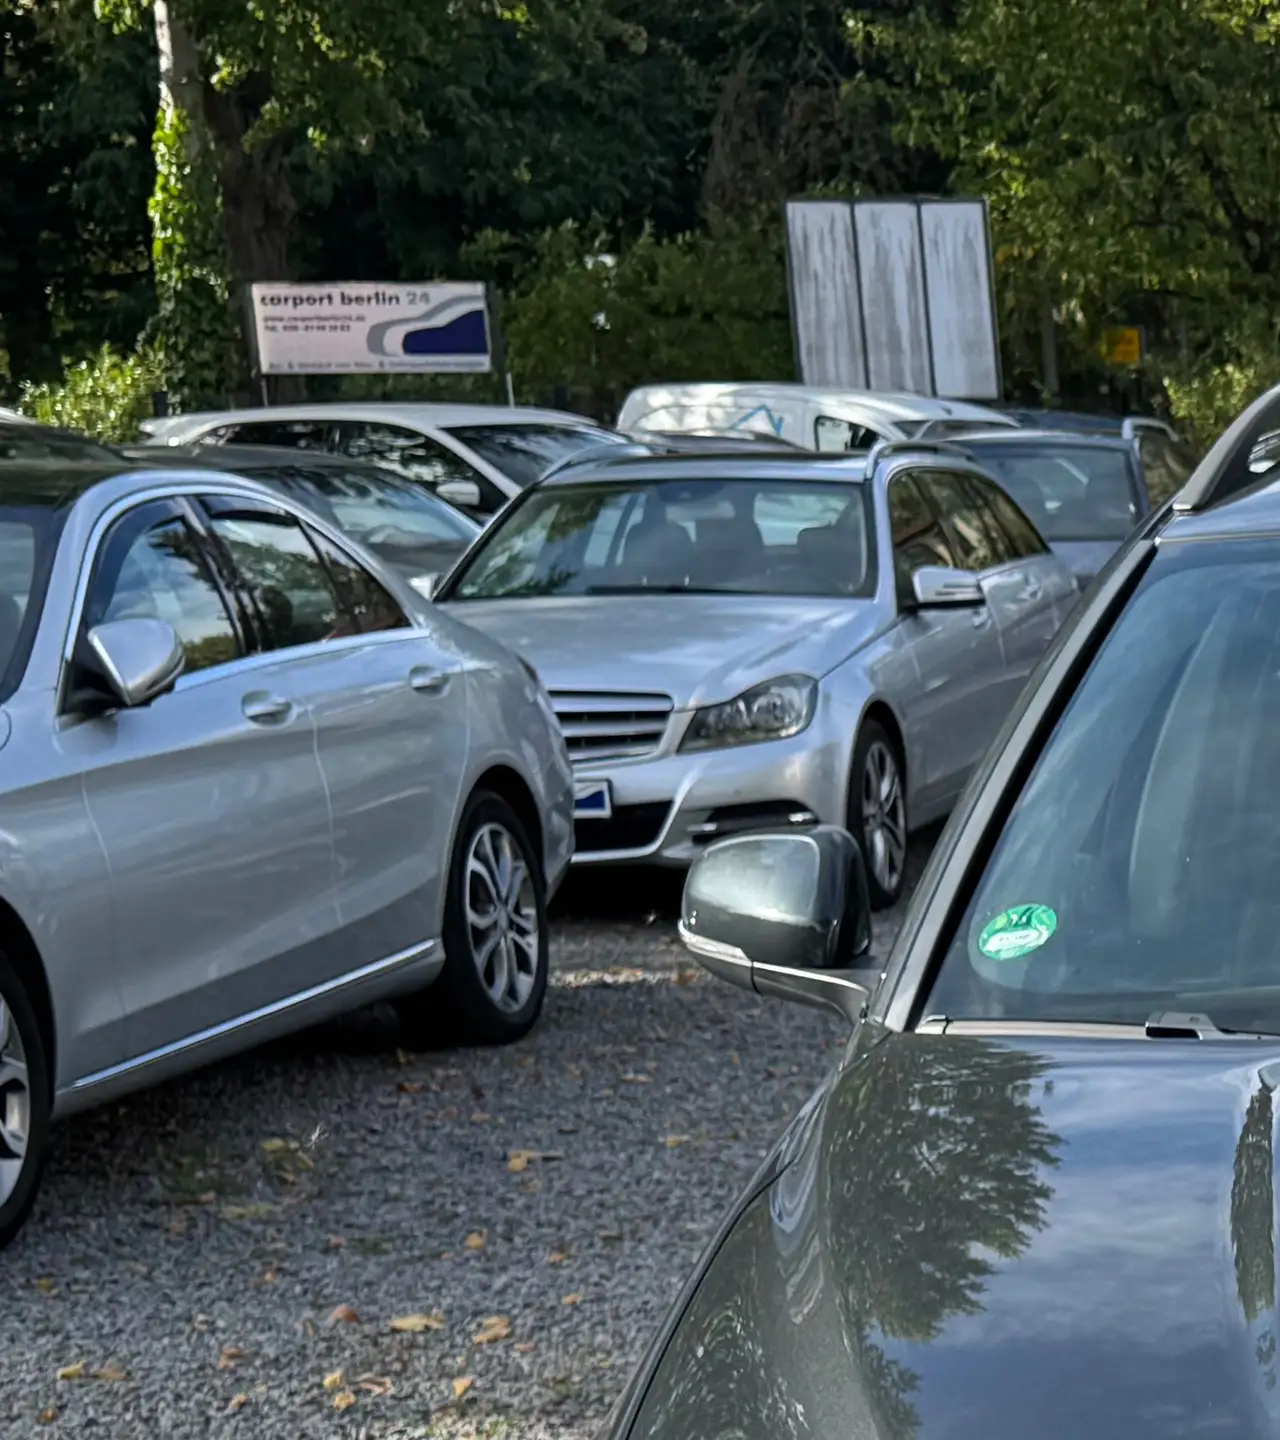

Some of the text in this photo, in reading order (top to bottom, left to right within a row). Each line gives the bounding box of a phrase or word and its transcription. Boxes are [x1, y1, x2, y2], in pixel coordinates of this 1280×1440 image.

[260, 291, 431, 309] carport berlin 24
